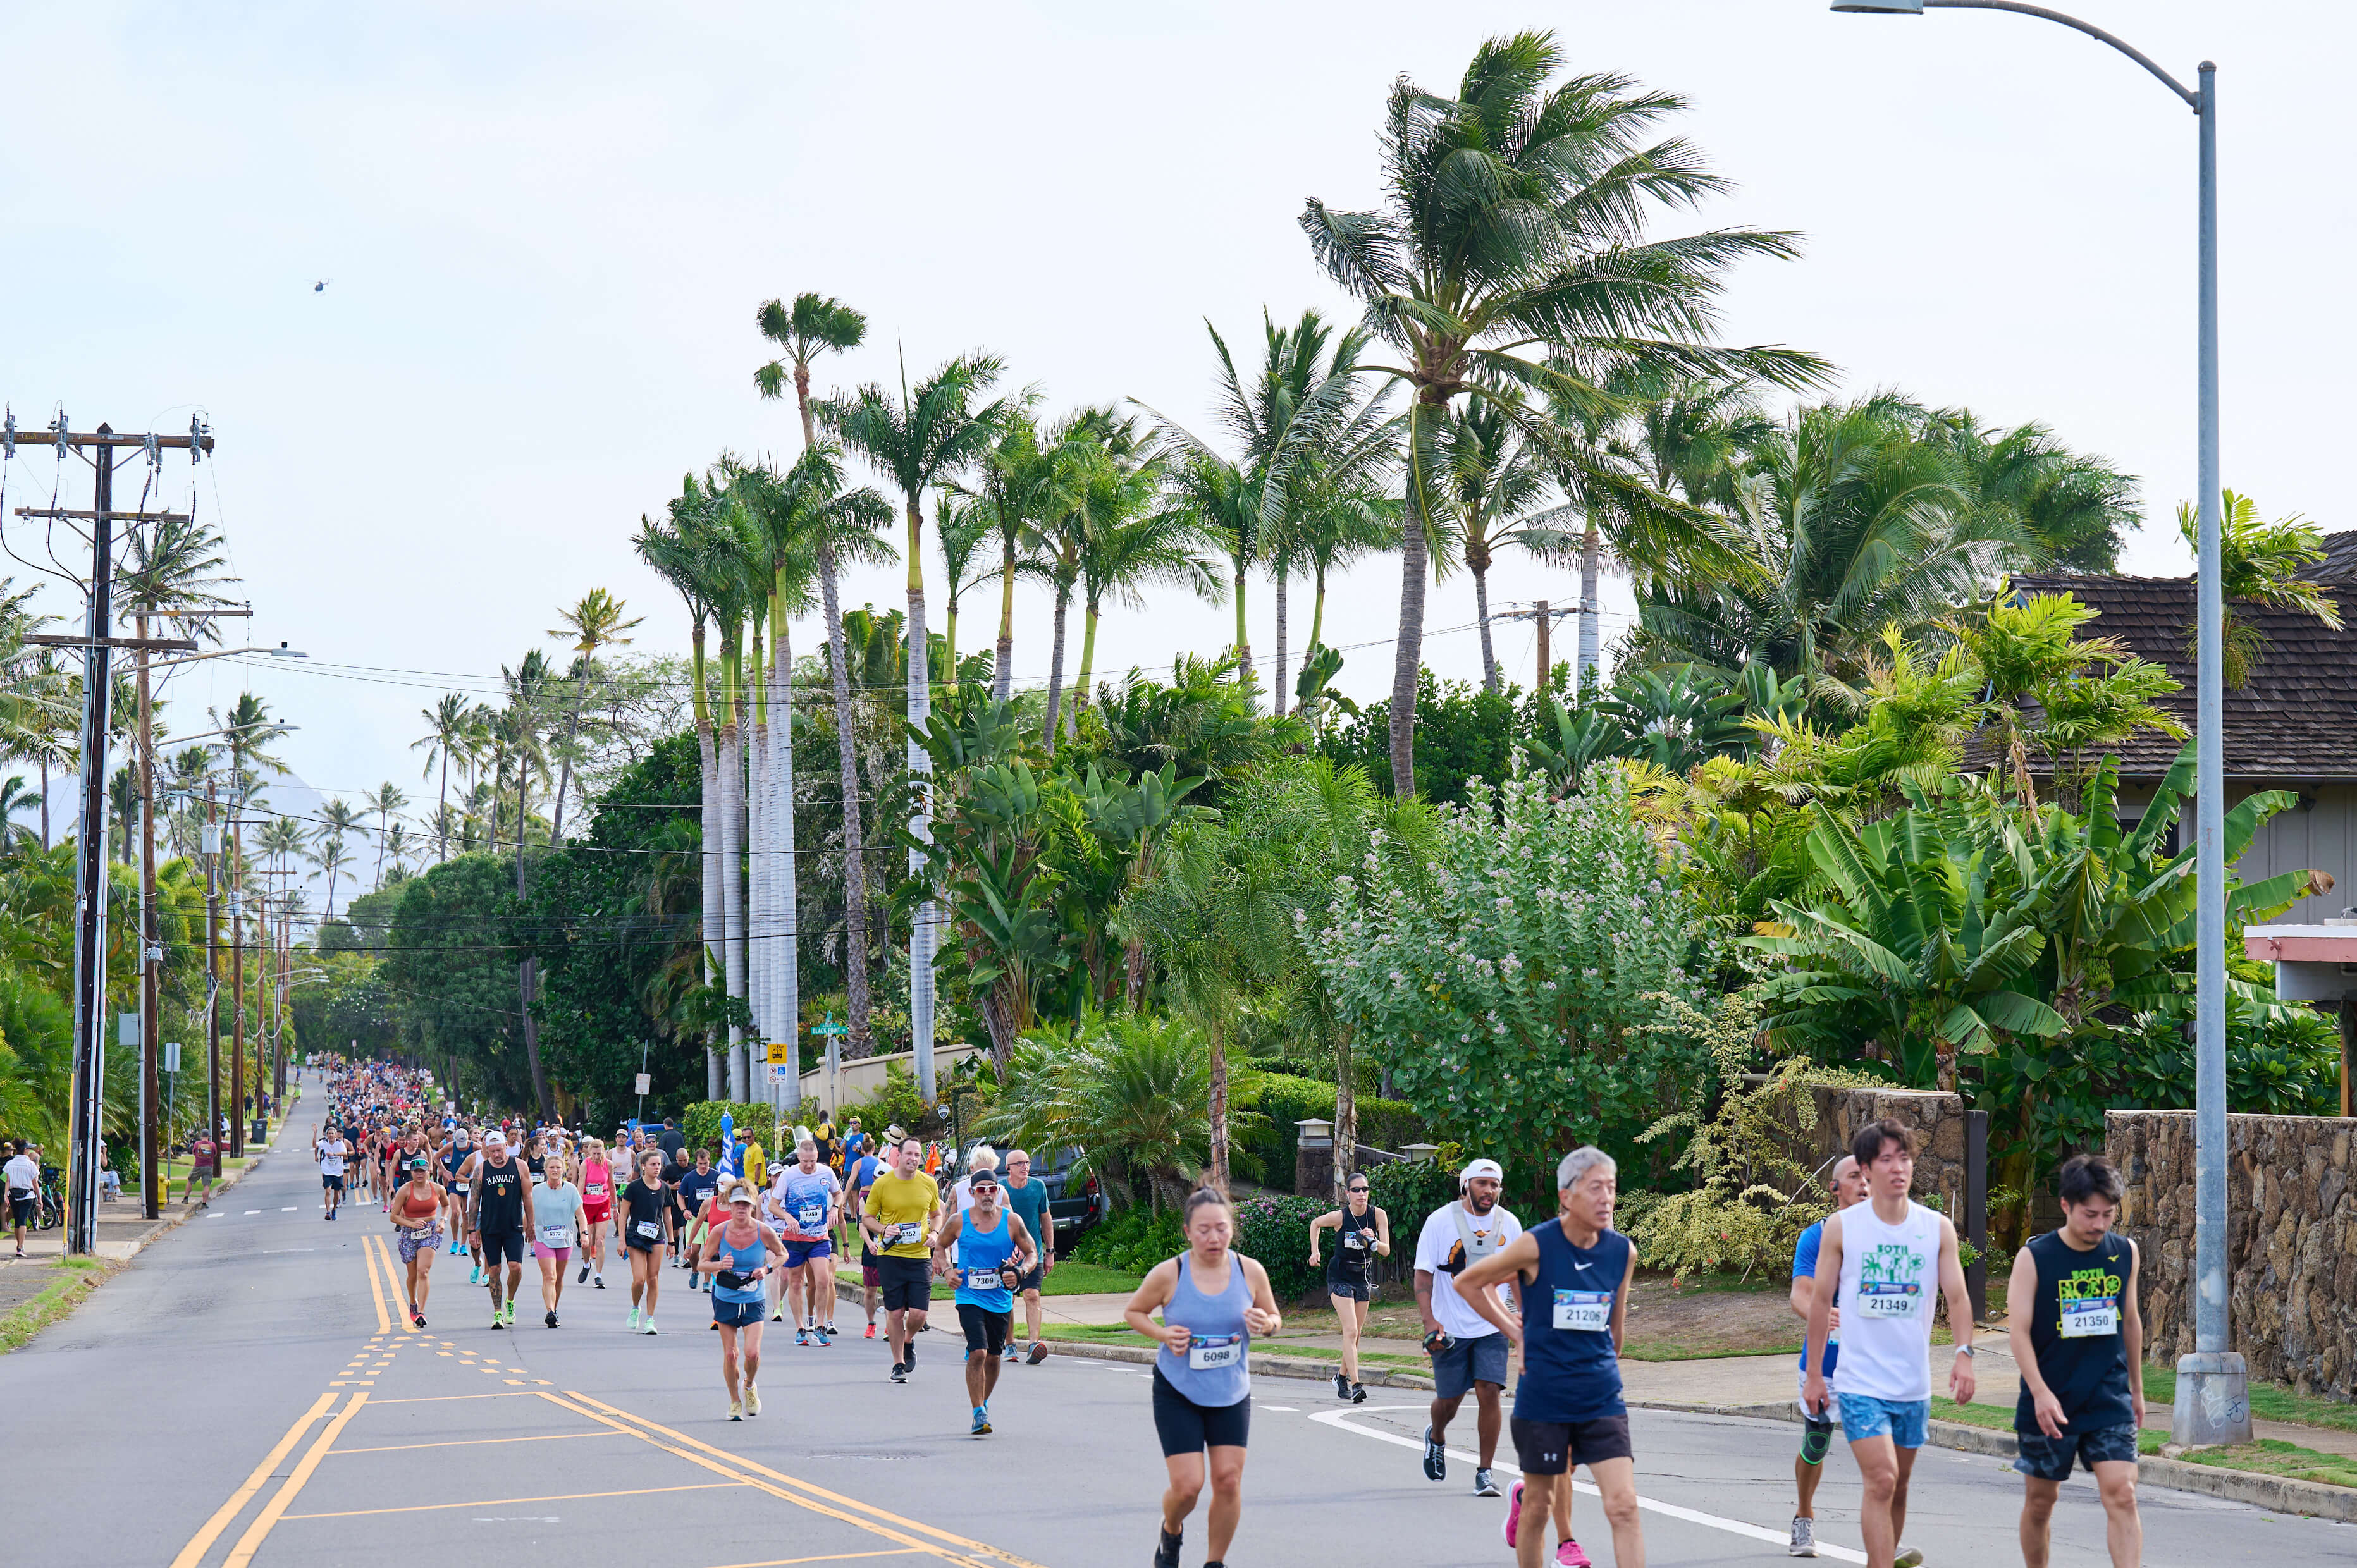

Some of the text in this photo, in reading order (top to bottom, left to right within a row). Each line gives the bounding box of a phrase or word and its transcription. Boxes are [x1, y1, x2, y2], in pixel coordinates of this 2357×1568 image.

[486, 1174, 514, 1185] HAWAII
[1871, 1298, 1907, 1311] 21349
[1566, 1309, 1601, 1321] 21206
[2074, 1315, 2108, 1328] 21350
[1203, 1351, 1229, 1361] 6098
